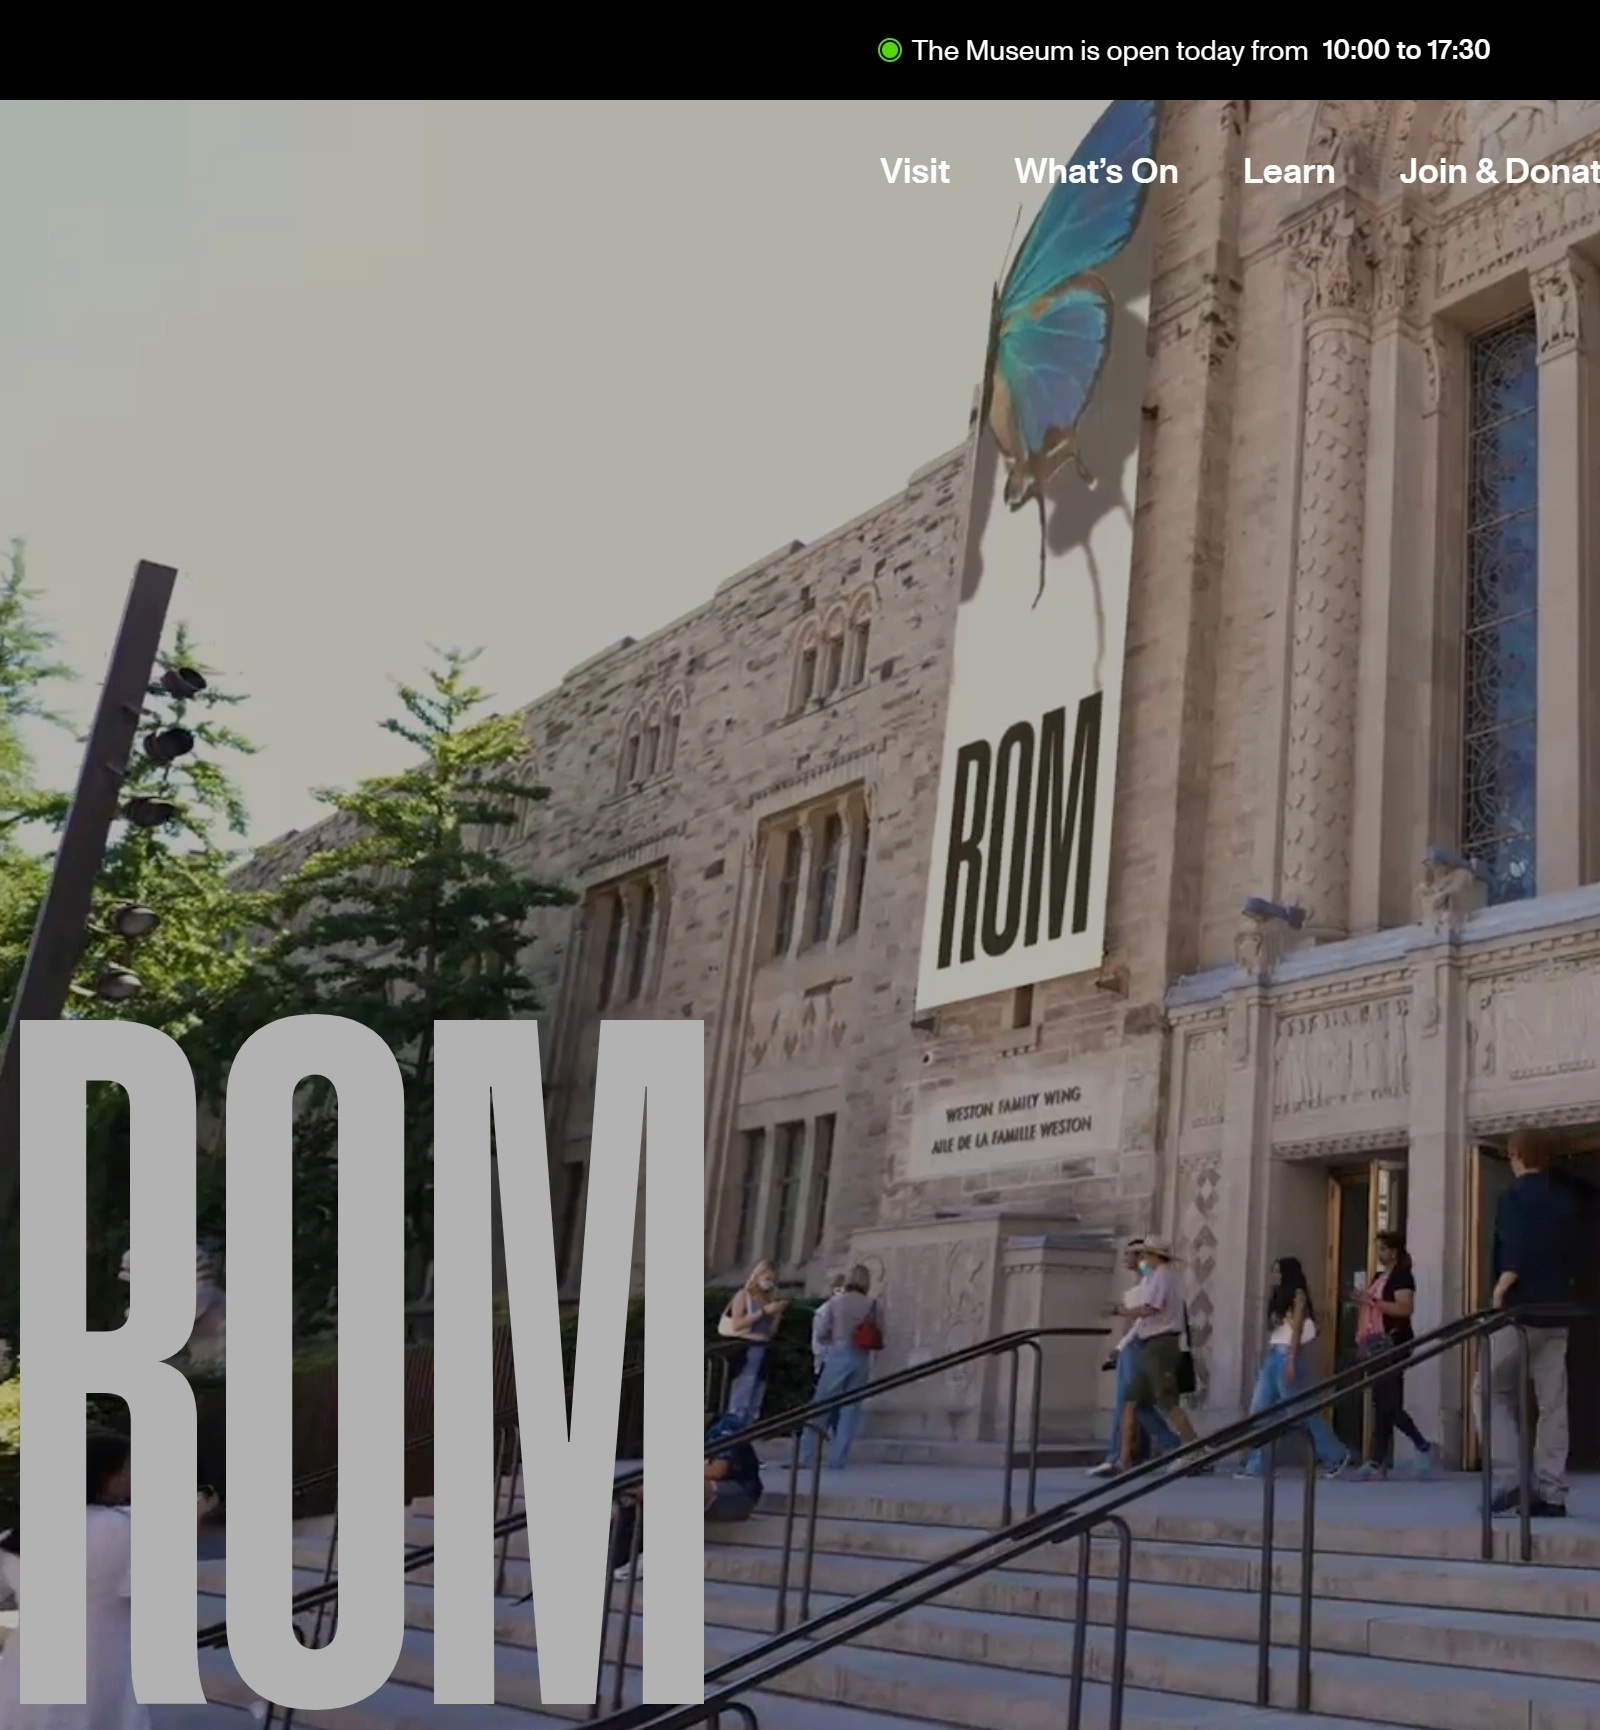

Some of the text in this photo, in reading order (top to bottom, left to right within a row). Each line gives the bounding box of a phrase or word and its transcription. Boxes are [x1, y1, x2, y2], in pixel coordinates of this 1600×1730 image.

[937, 690, 1104, 970] ROM
[946, 1086, 1081, 1122] WESTON FAMILY WING
[931, 1115, 1092, 1155] AILE DE LA FAMILLE WESTON
